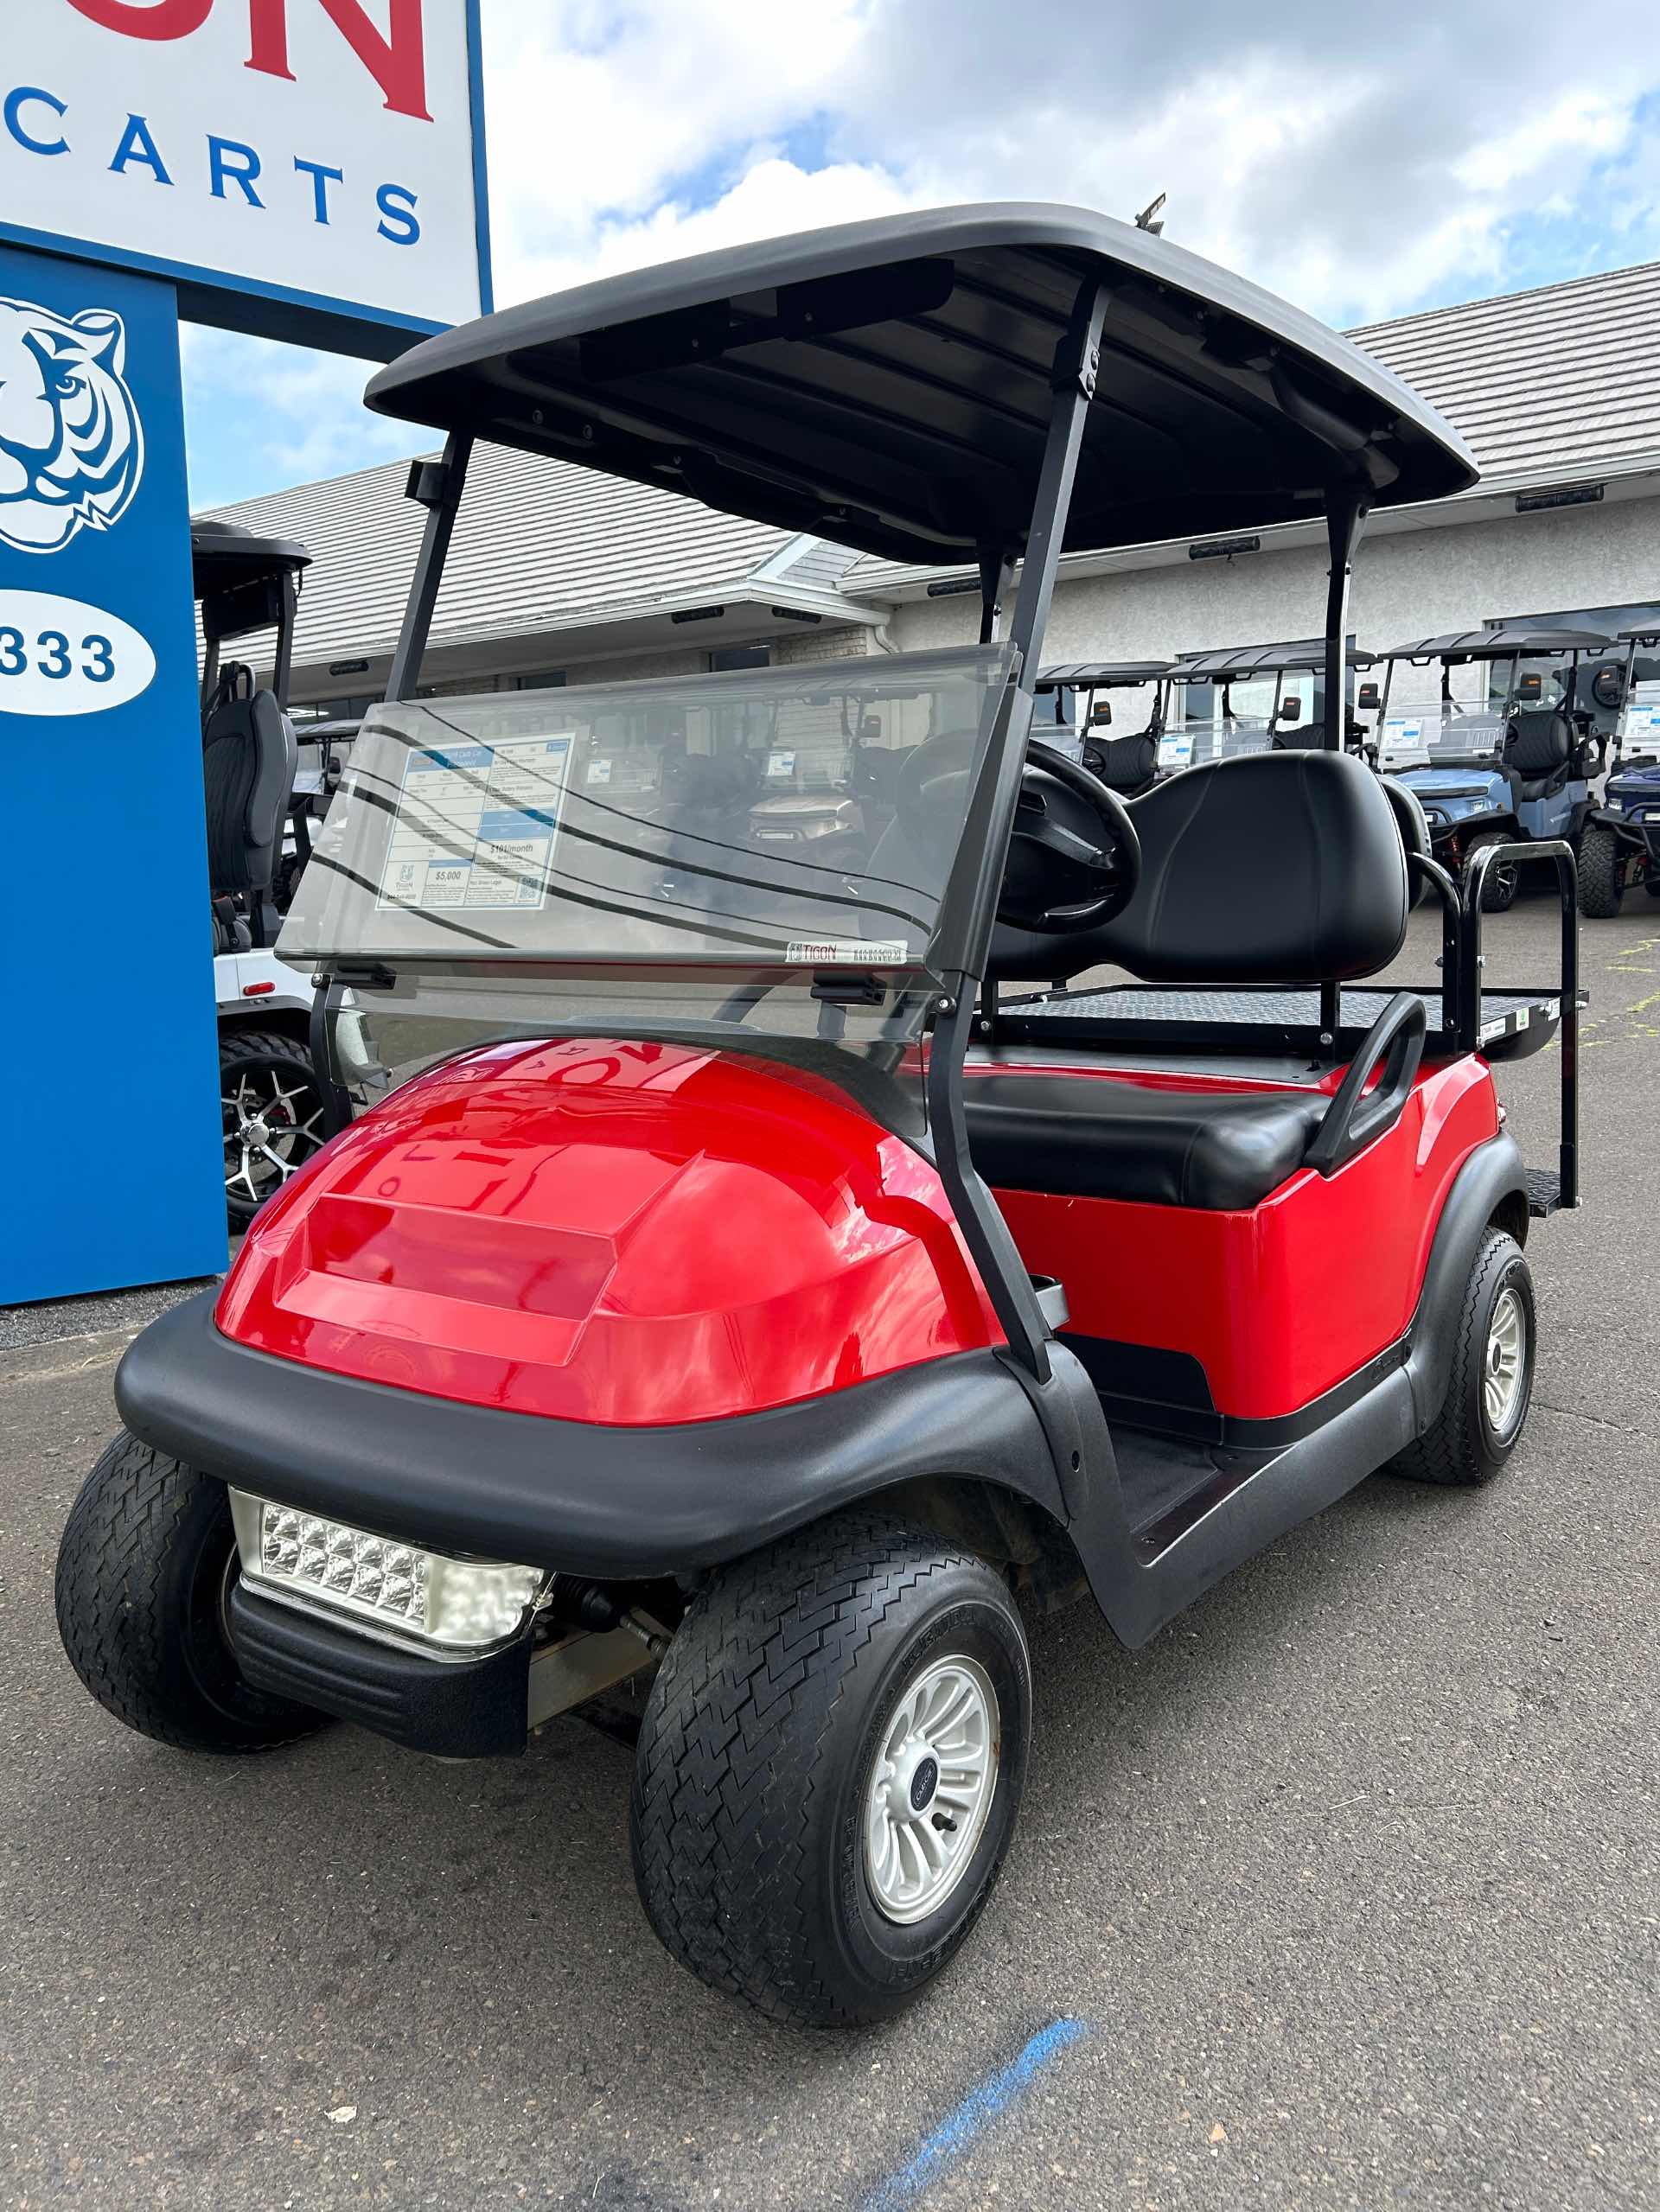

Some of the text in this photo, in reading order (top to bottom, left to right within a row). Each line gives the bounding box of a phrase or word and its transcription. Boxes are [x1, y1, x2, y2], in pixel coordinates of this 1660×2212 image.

[3, 86, 421, 245] CARTS
[0, 626, 116, 683] 333
[435, 870, 462, 882] $5,000
[802, 944, 837, 960] TIGON
